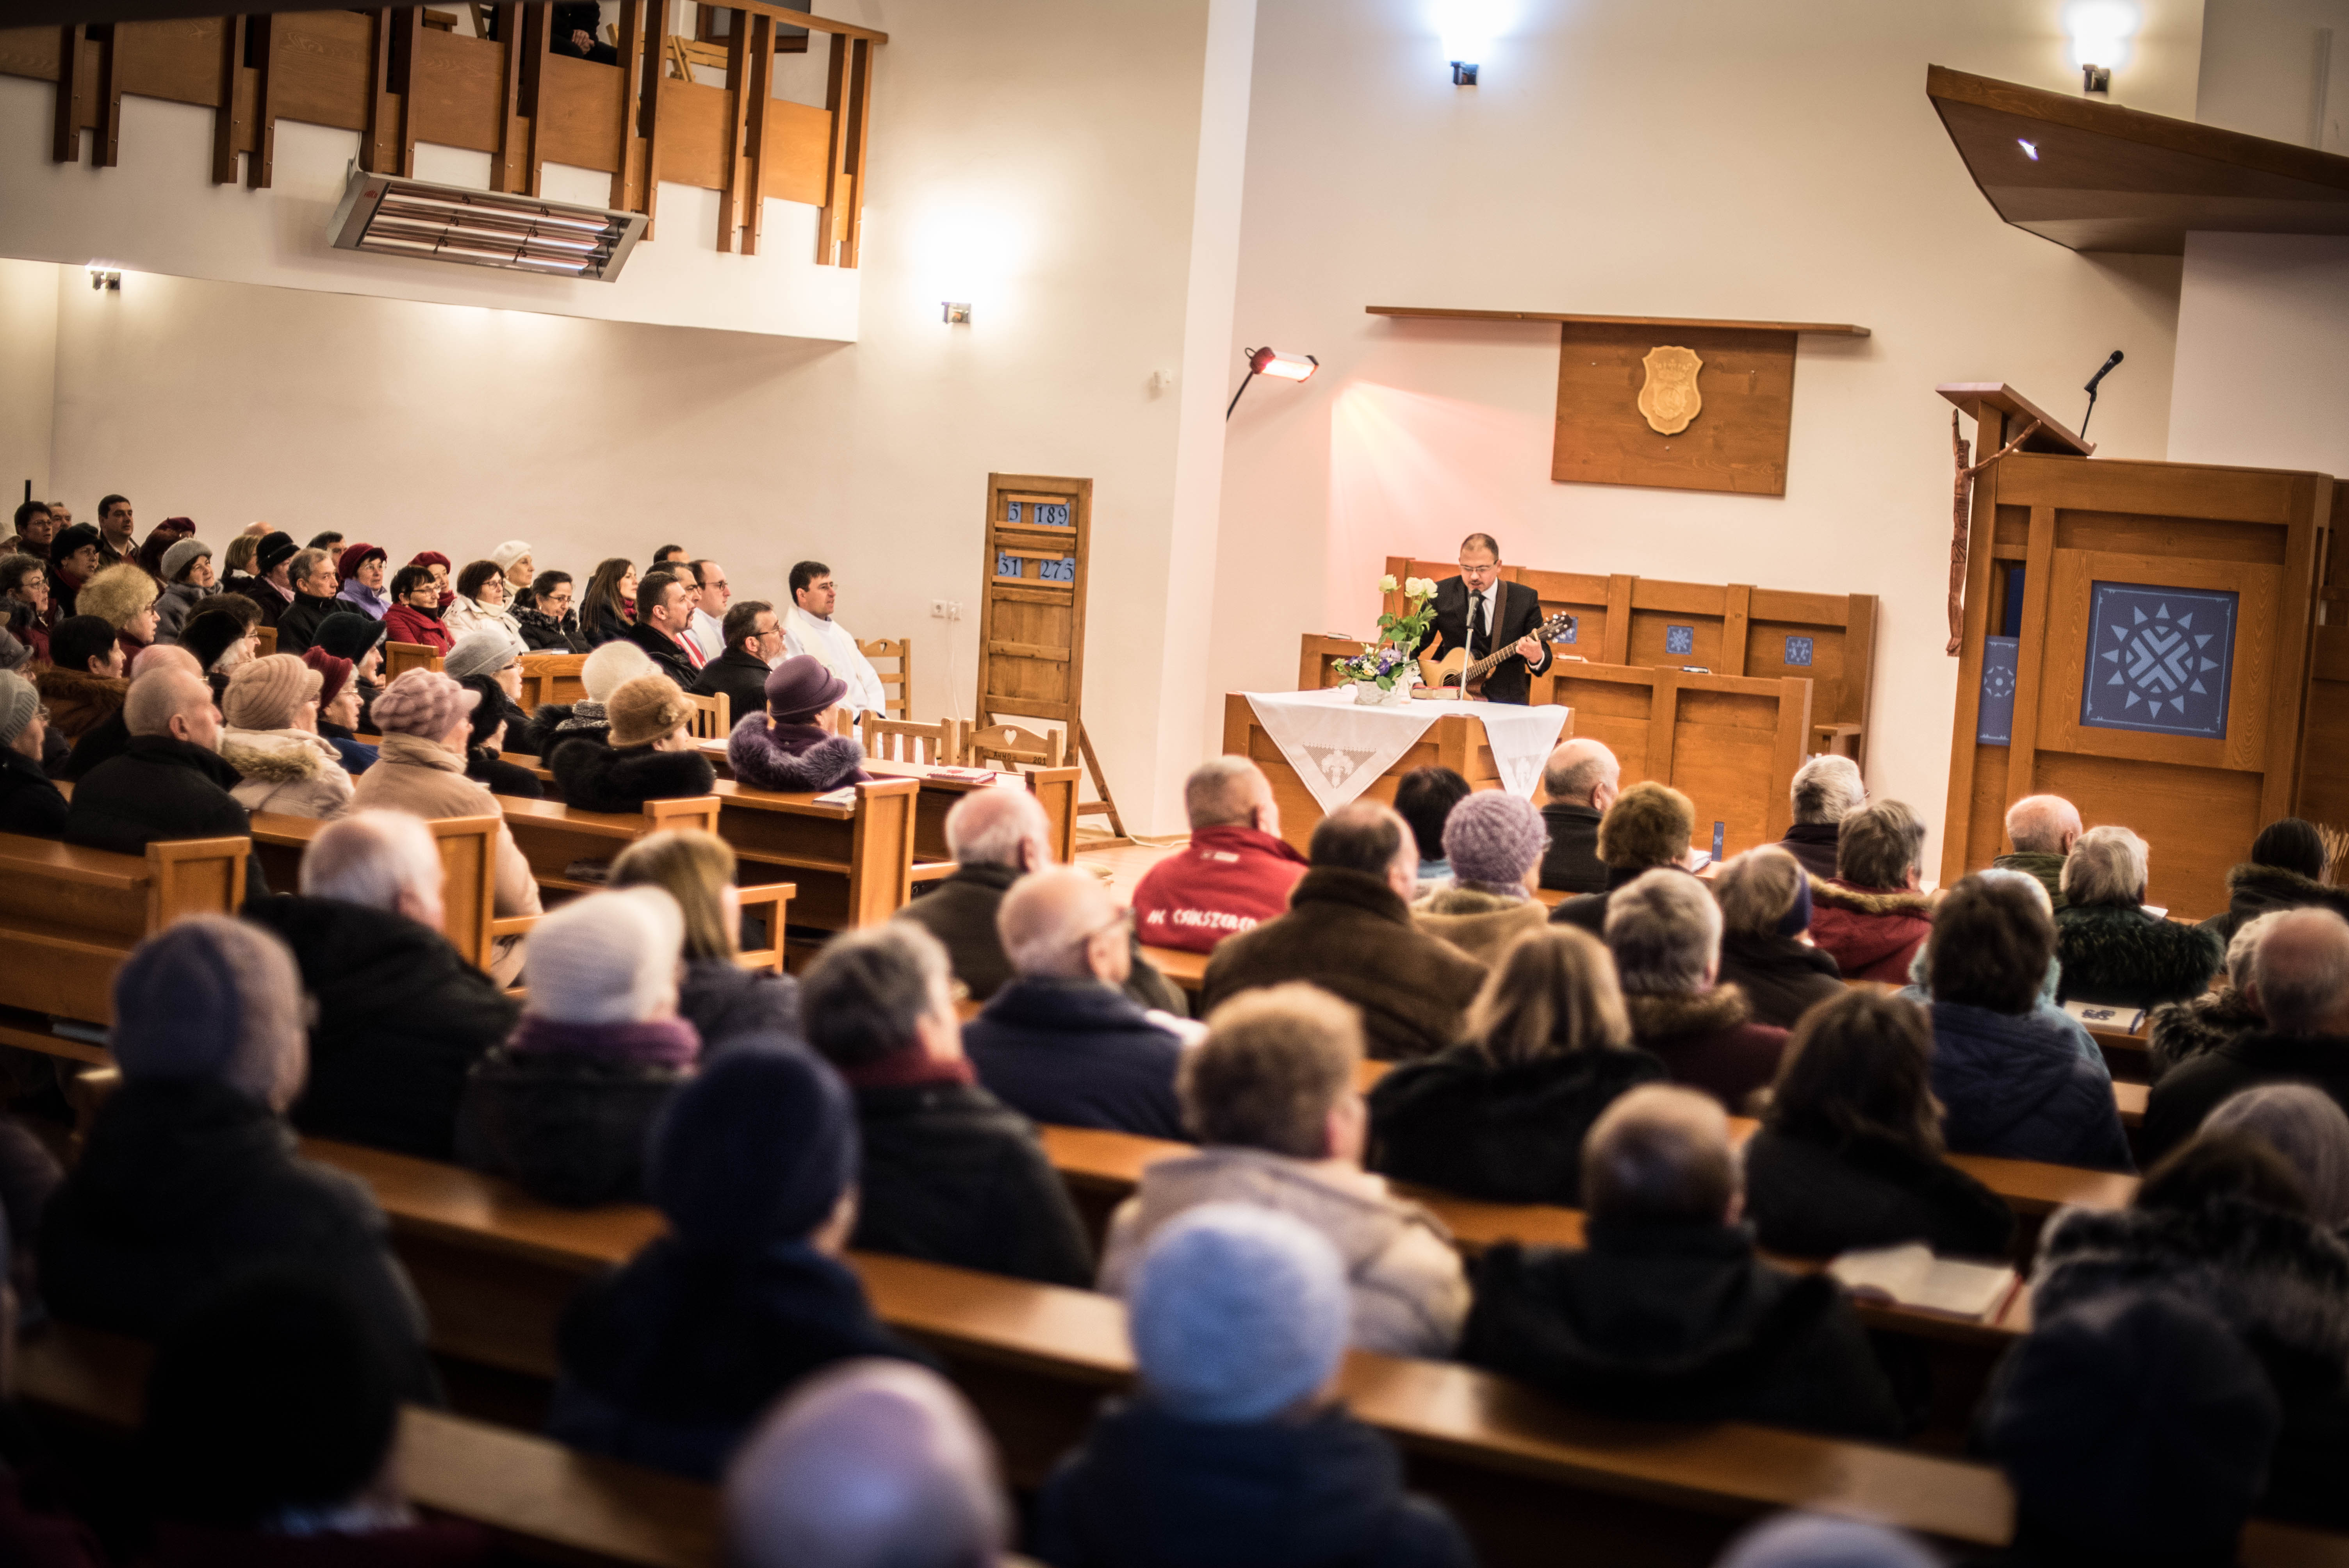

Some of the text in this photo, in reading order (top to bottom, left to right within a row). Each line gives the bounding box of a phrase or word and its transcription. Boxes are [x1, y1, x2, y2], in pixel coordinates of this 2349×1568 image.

[1009, 504, 1068, 524] 5 189
[999, 558, 1074, 580] 31 275
[993, 751, 1011, 760] ANNO
